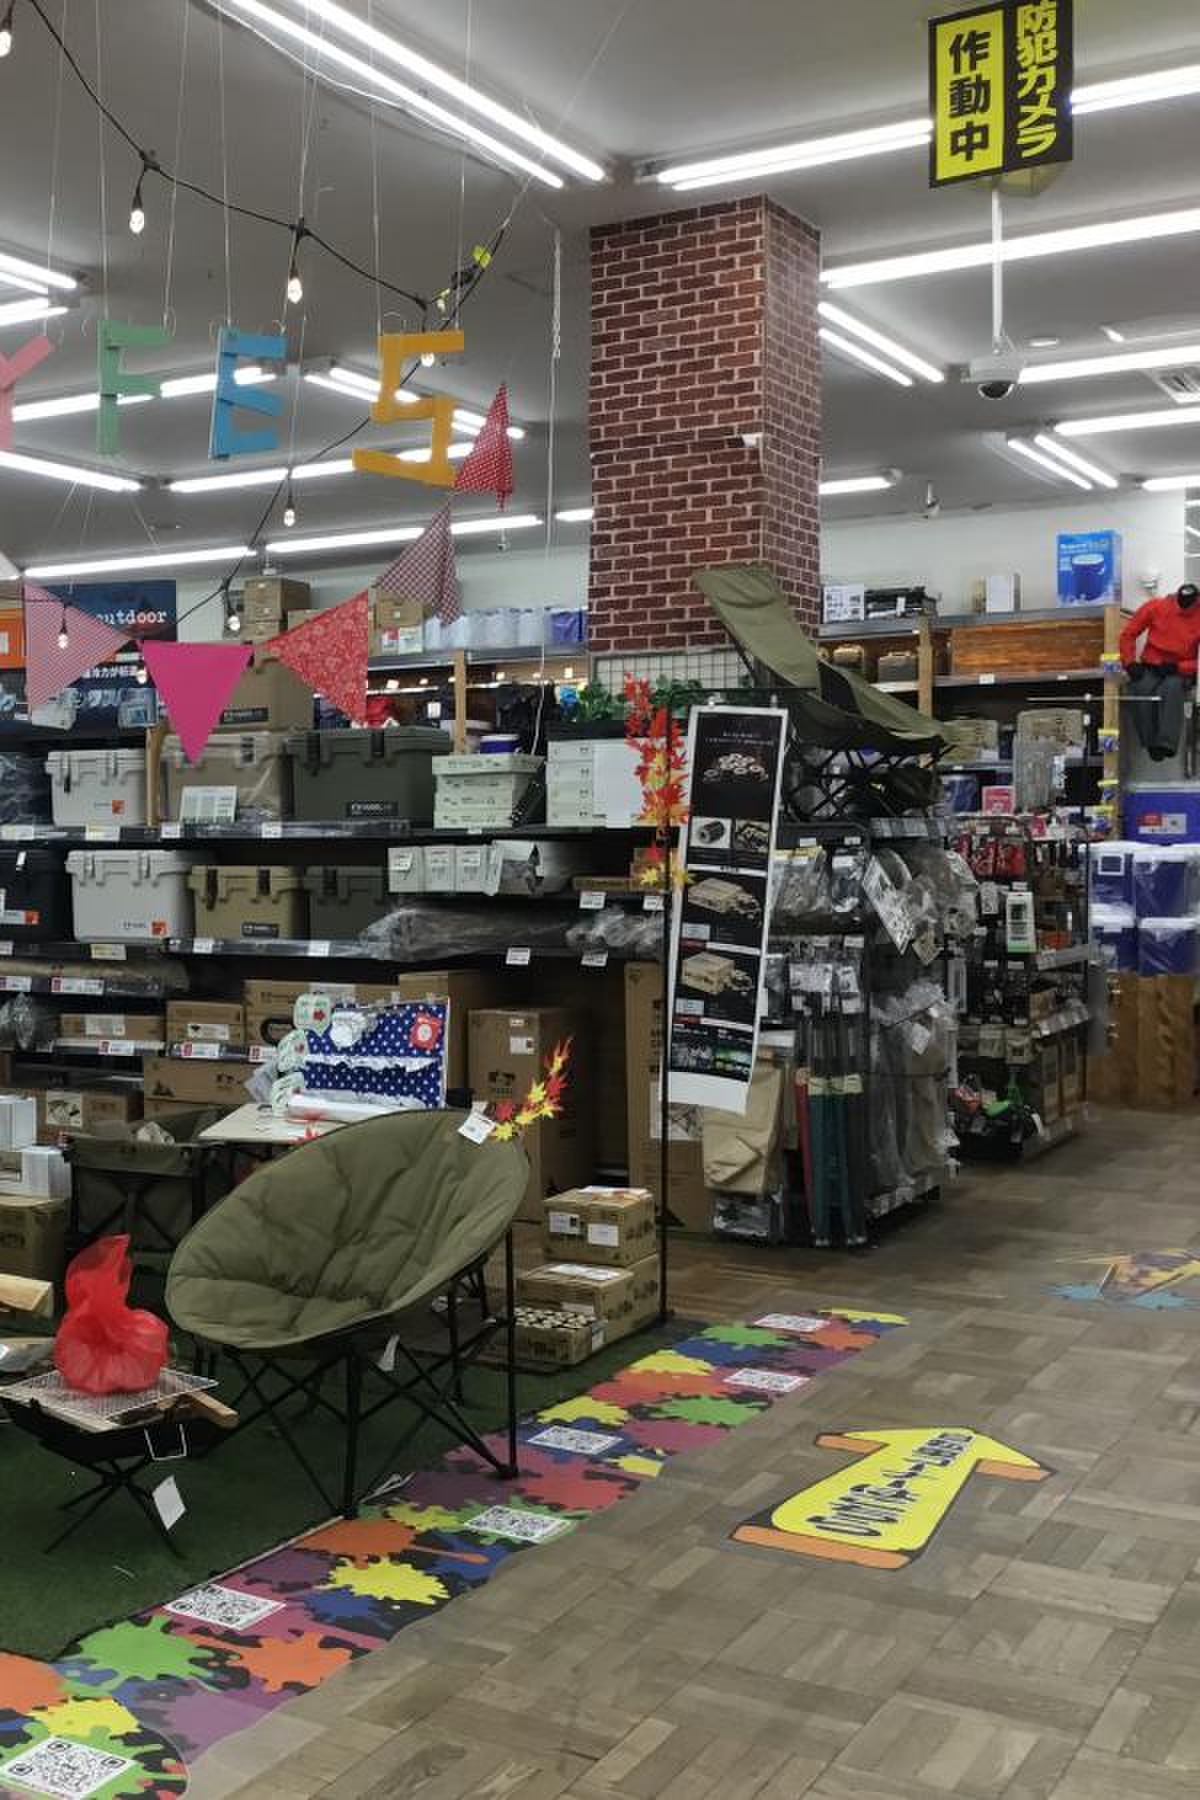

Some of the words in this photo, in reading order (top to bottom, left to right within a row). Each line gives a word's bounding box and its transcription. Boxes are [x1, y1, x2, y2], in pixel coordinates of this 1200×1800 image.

[948, 30, 991, 161] 作動中
[1016, 0, 1057, 158] 防犯カメラ
